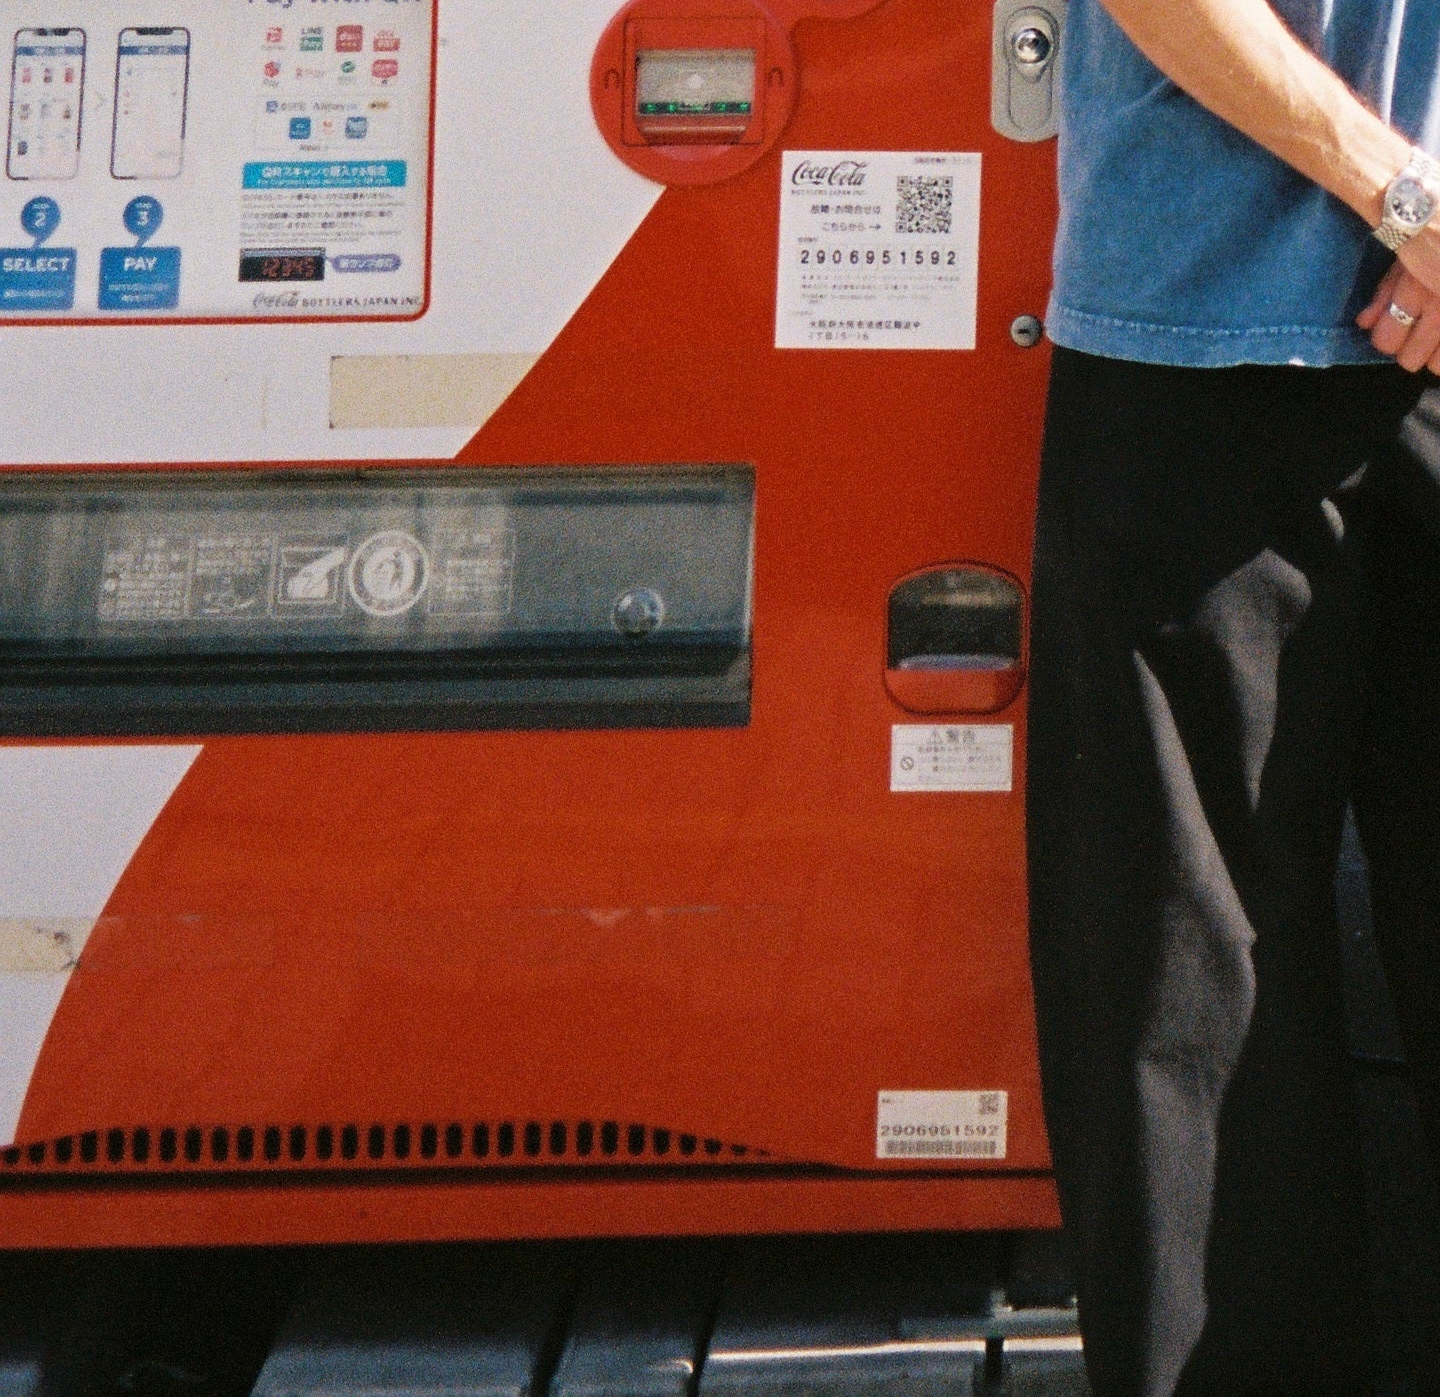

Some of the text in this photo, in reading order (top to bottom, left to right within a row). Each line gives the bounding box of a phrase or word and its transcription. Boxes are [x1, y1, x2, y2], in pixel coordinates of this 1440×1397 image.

[792, 160, 869, 186] Coca-Cola
[34, 212, 46, 226] 2
[137, 211, 149, 226] 3
[3, 257, 70, 272] SELECT
[124, 257, 157, 272] PAY
[800, 250, 956, 265] 2906951592
